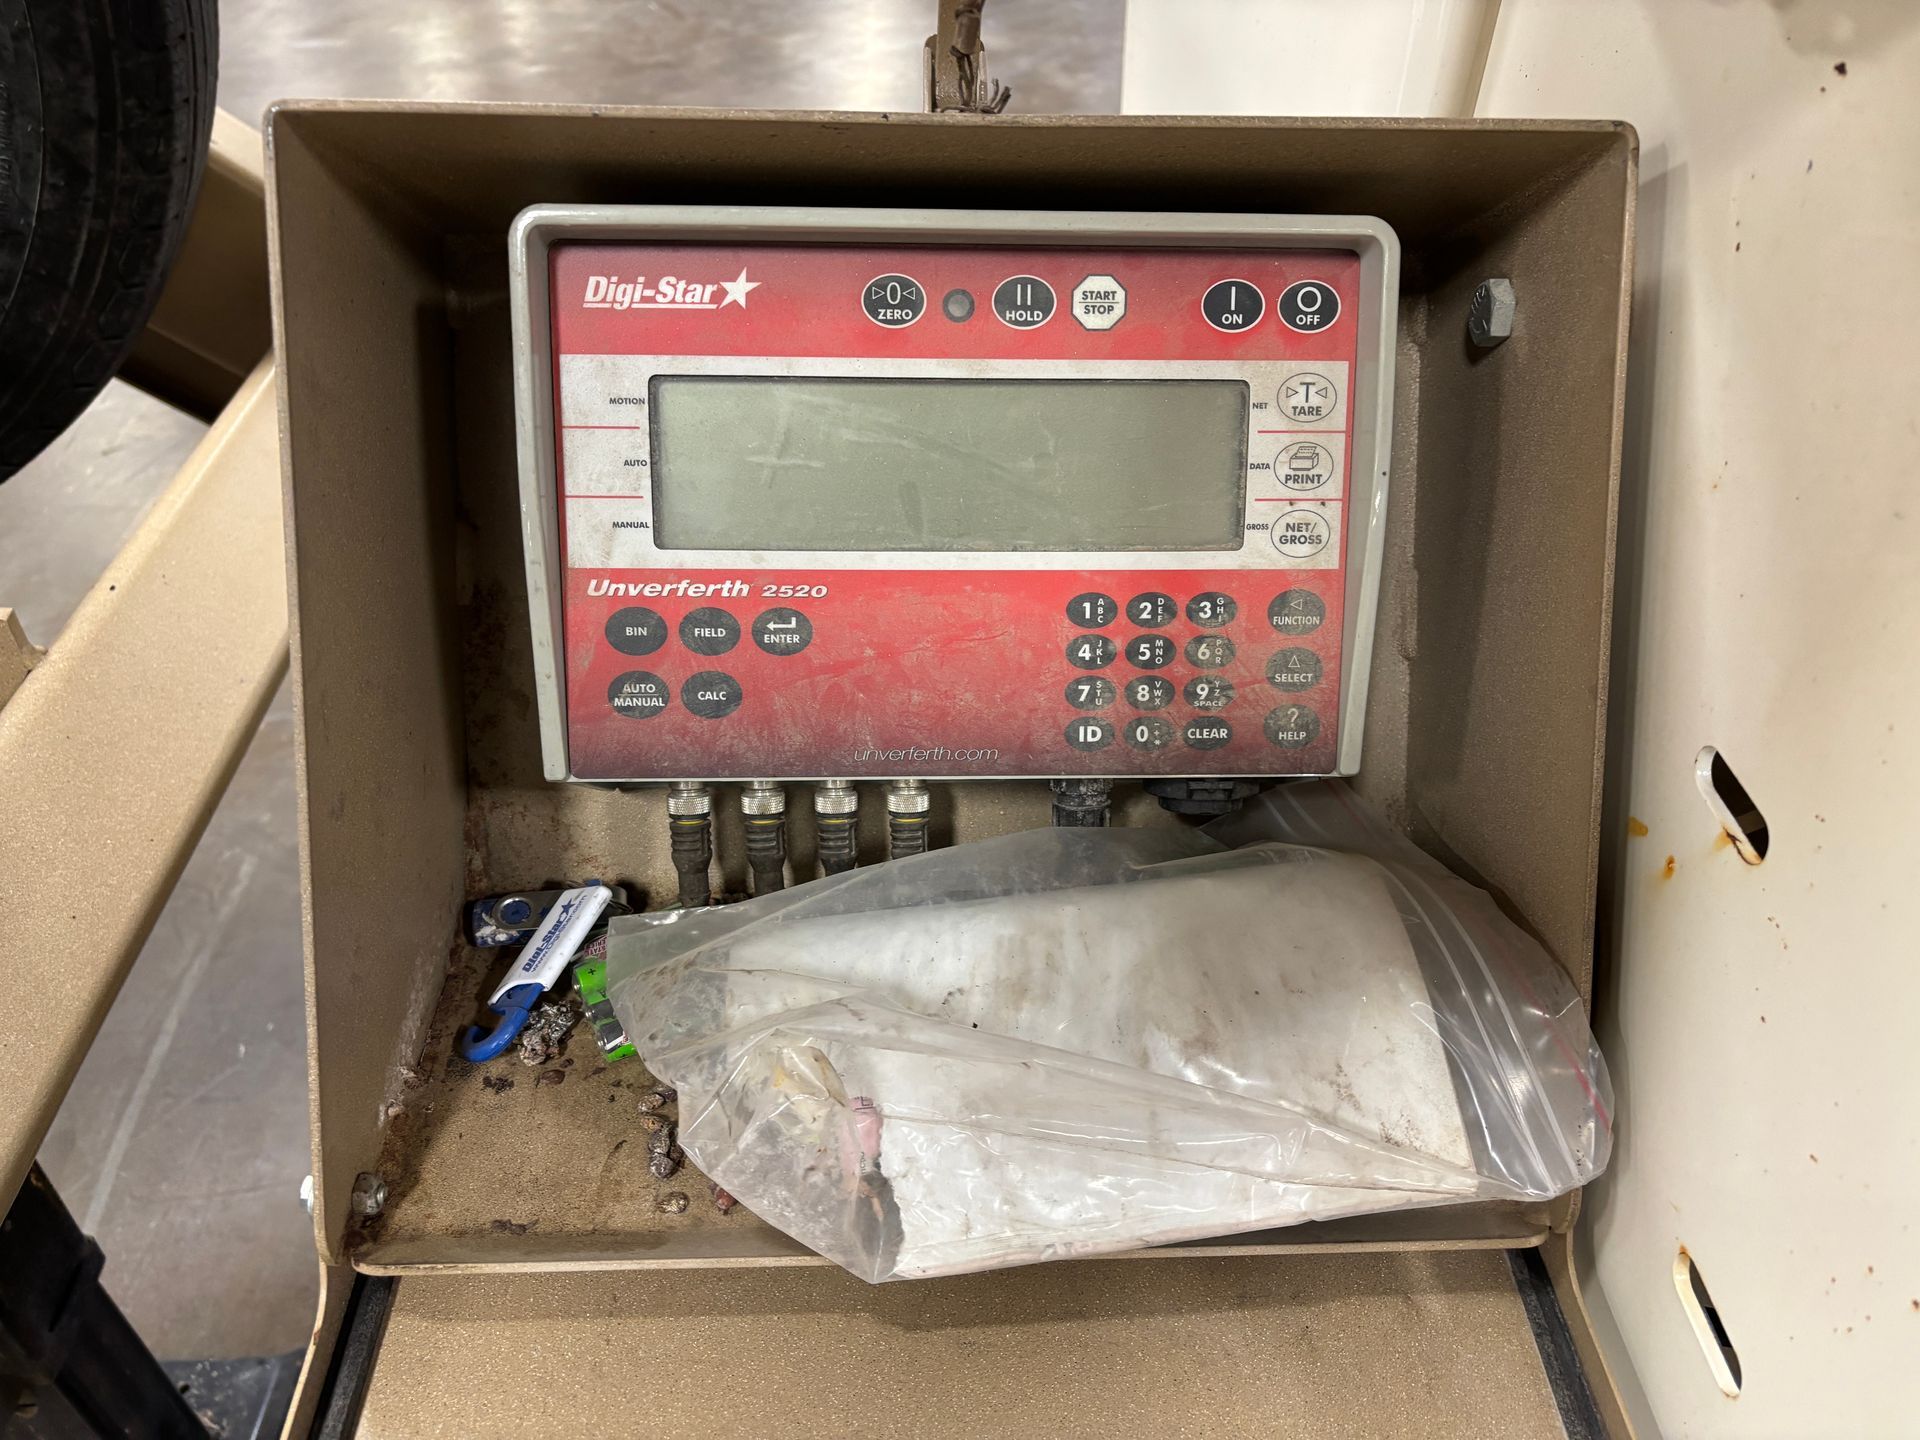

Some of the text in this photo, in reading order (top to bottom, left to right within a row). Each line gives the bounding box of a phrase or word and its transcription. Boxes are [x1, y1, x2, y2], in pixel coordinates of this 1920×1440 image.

[584, 275, 717, 309] Digi-Star
[1082, 291, 1117, 301] START
[877, 308, 912, 320] ZERO
[1083, 304, 1114, 315] STOP
[1006, 310, 1043, 322] HOLD
[1221, 313, 1243, 325] ON
[1296, 314, 1320, 325] OFF
[609, 397, 645, 405] MOTION
[1252, 402, 1268, 410] NET
[1292, 406, 1322, 416] TARE
[624, 459, 647, 467] AUTO
[1284, 474, 1322, 485] PRINT
[612, 521, 649, 529] MANUAL
[1246, 523, 1269, 531] GROSS
[1285, 522, 1317, 534] NET/
[1279, 534, 1322, 545] GROSS
[587, 579, 828, 598] Unverferth 2520
[1083, 602, 1091, 619] 1
[1139, 602, 1152, 620] 2
[1199, 601, 1212, 619] 3
[1273, 616, 1320, 625] FUNCTION
[625, 626, 647, 636] BIN
[694, 628, 726, 638] FIELD
[764, 634, 800, 644] ENTER
[1078, 644, 1091, 661] 4
[1138, 644, 1150, 660] 5
[1197, 643, 1210, 660] 6
[1274, 673, 1313, 682] SELECT
[623, 683, 656, 693] AUTO
[1078, 685, 1091, 702] 7
[1136, 685, 1150, 701] 8
[1196, 684, 1209, 700] 9
[698, 691, 727, 701] CALC
[614, 697, 665, 707] MANUAL
[1078, 726, 1102, 742] ID
[1136, 726, 1149, 742] 0
[1187, 728, 1228, 739] CLEAR
[1278, 731, 1306, 740] HELP
[854, 746, 998, 762] unverferth.com
